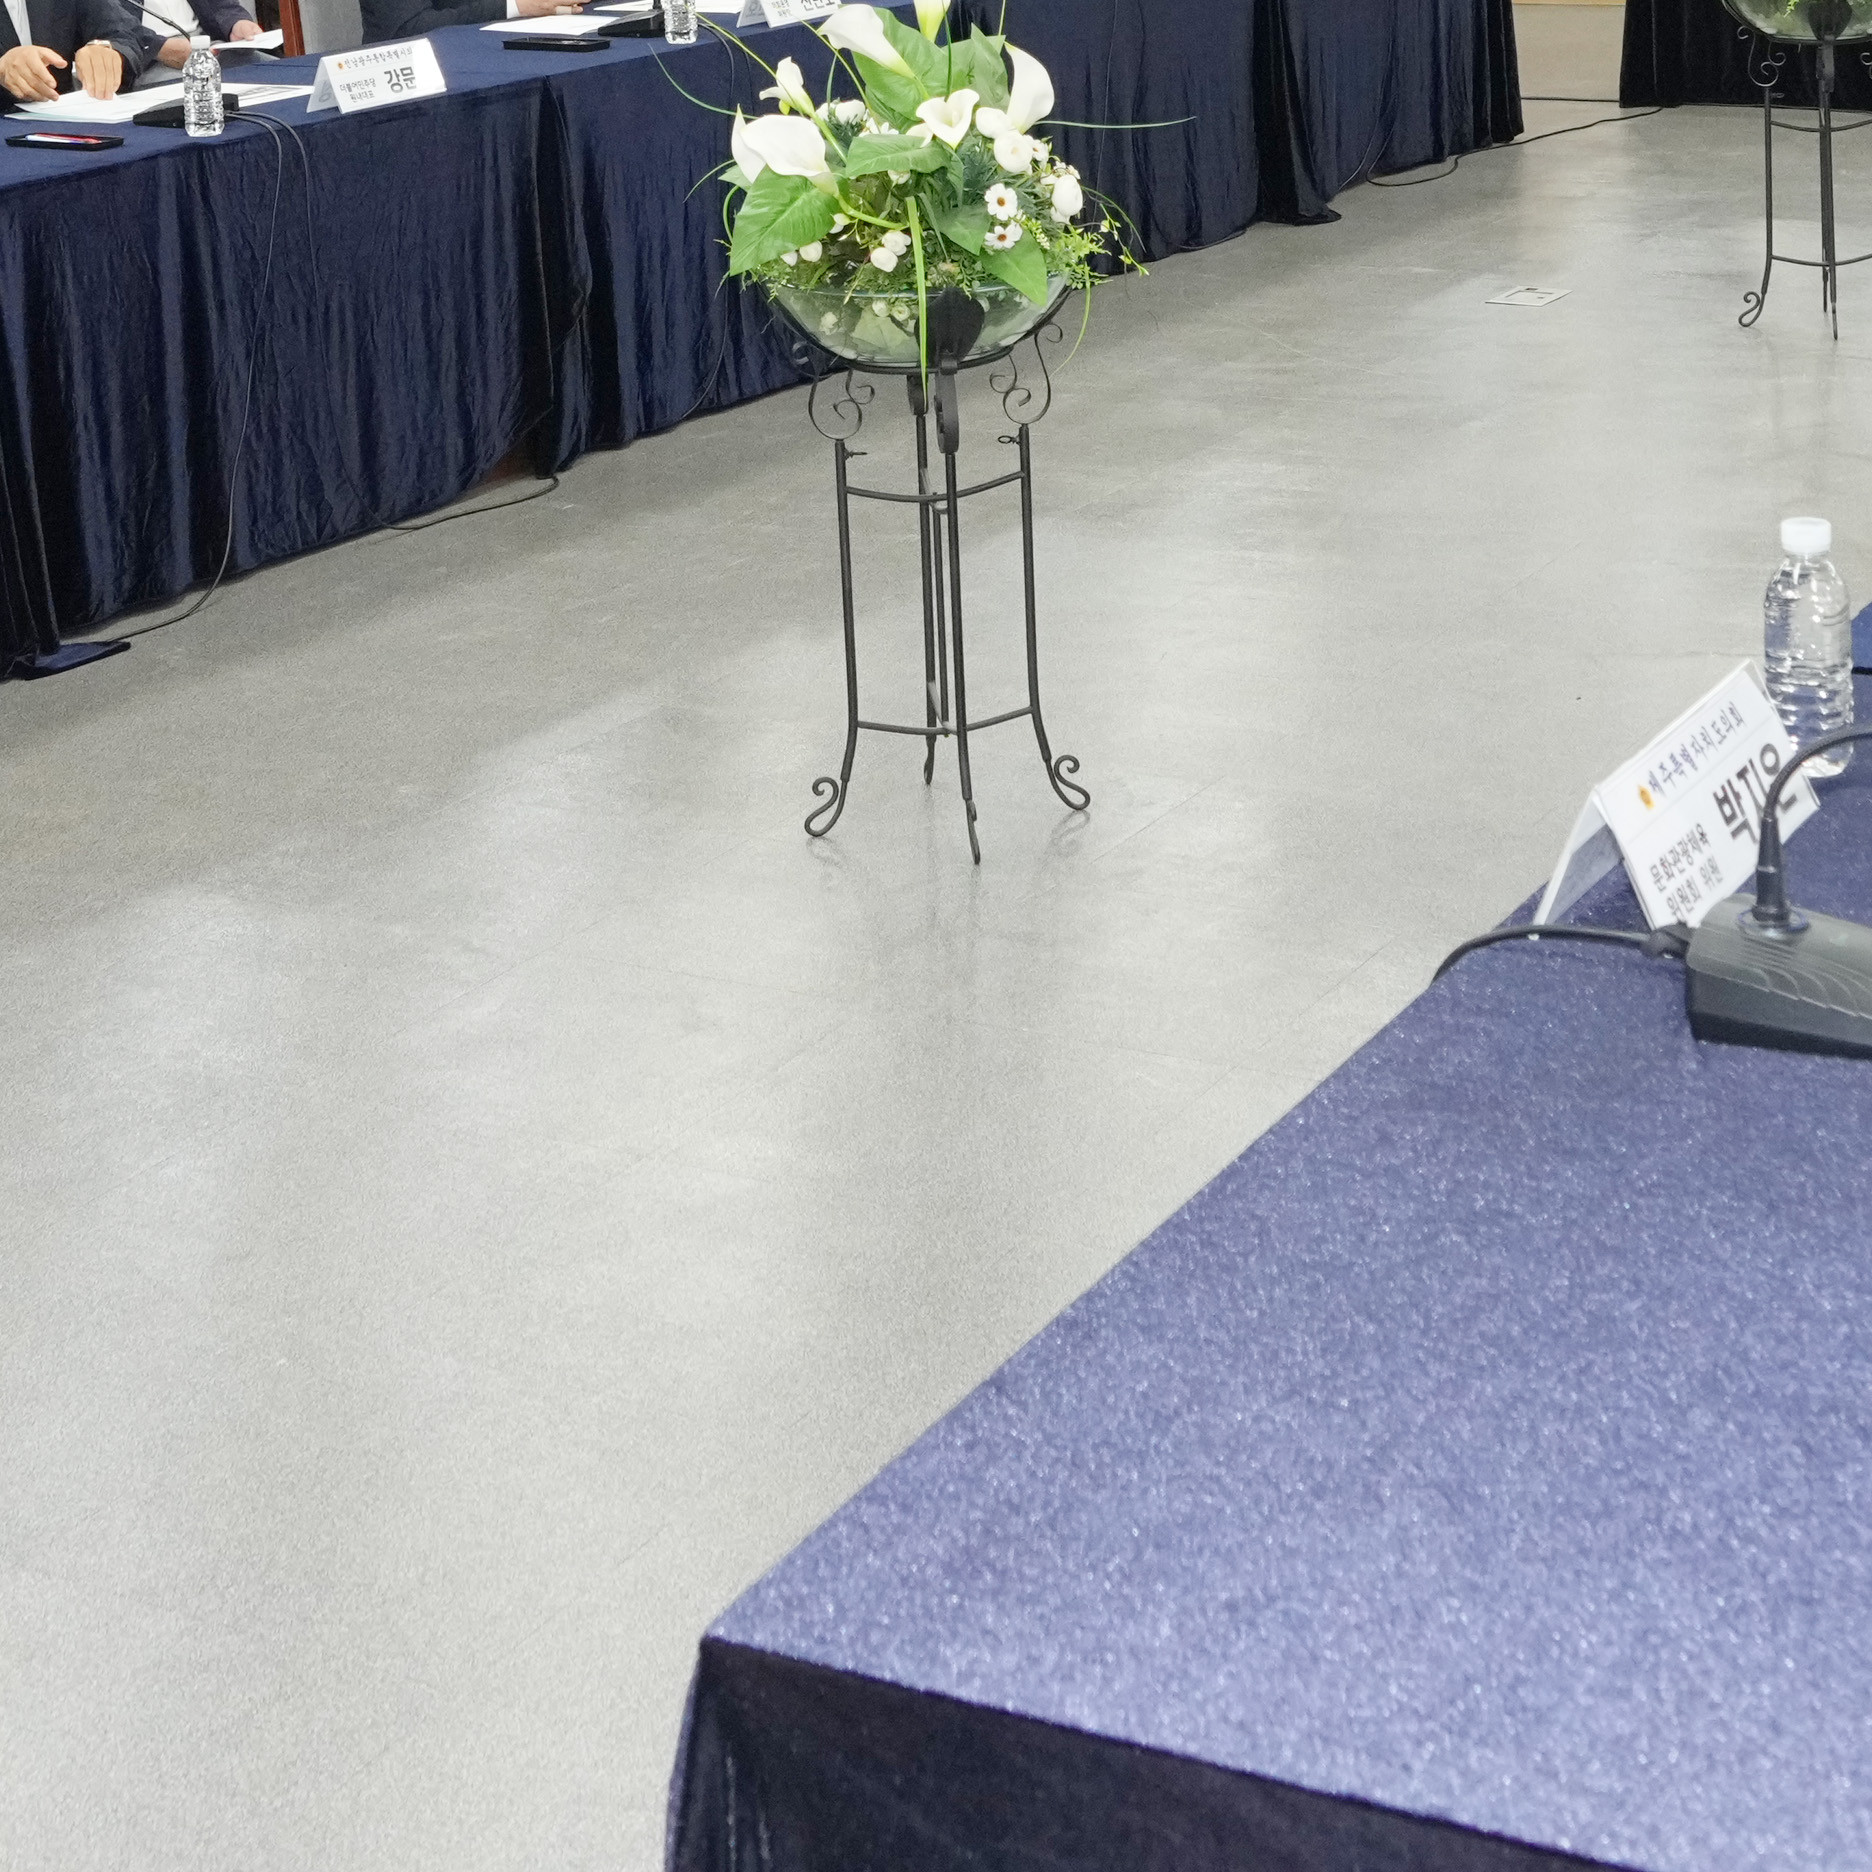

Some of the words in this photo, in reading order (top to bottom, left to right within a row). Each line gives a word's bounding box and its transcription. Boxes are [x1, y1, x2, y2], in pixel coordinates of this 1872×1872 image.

[344, 46, 413, 70] 전남광주통합특별시의
[384, 66, 417, 94] 강문
[339, 78, 377, 95] 더불어민주당
[1649, 702, 1746, 797] 제주특별자치도의회
[1648, 823, 1710, 894] 문화관광체육
[1665, 878, 1703, 918] 위원회
[1699, 856, 1724, 892] 위원
